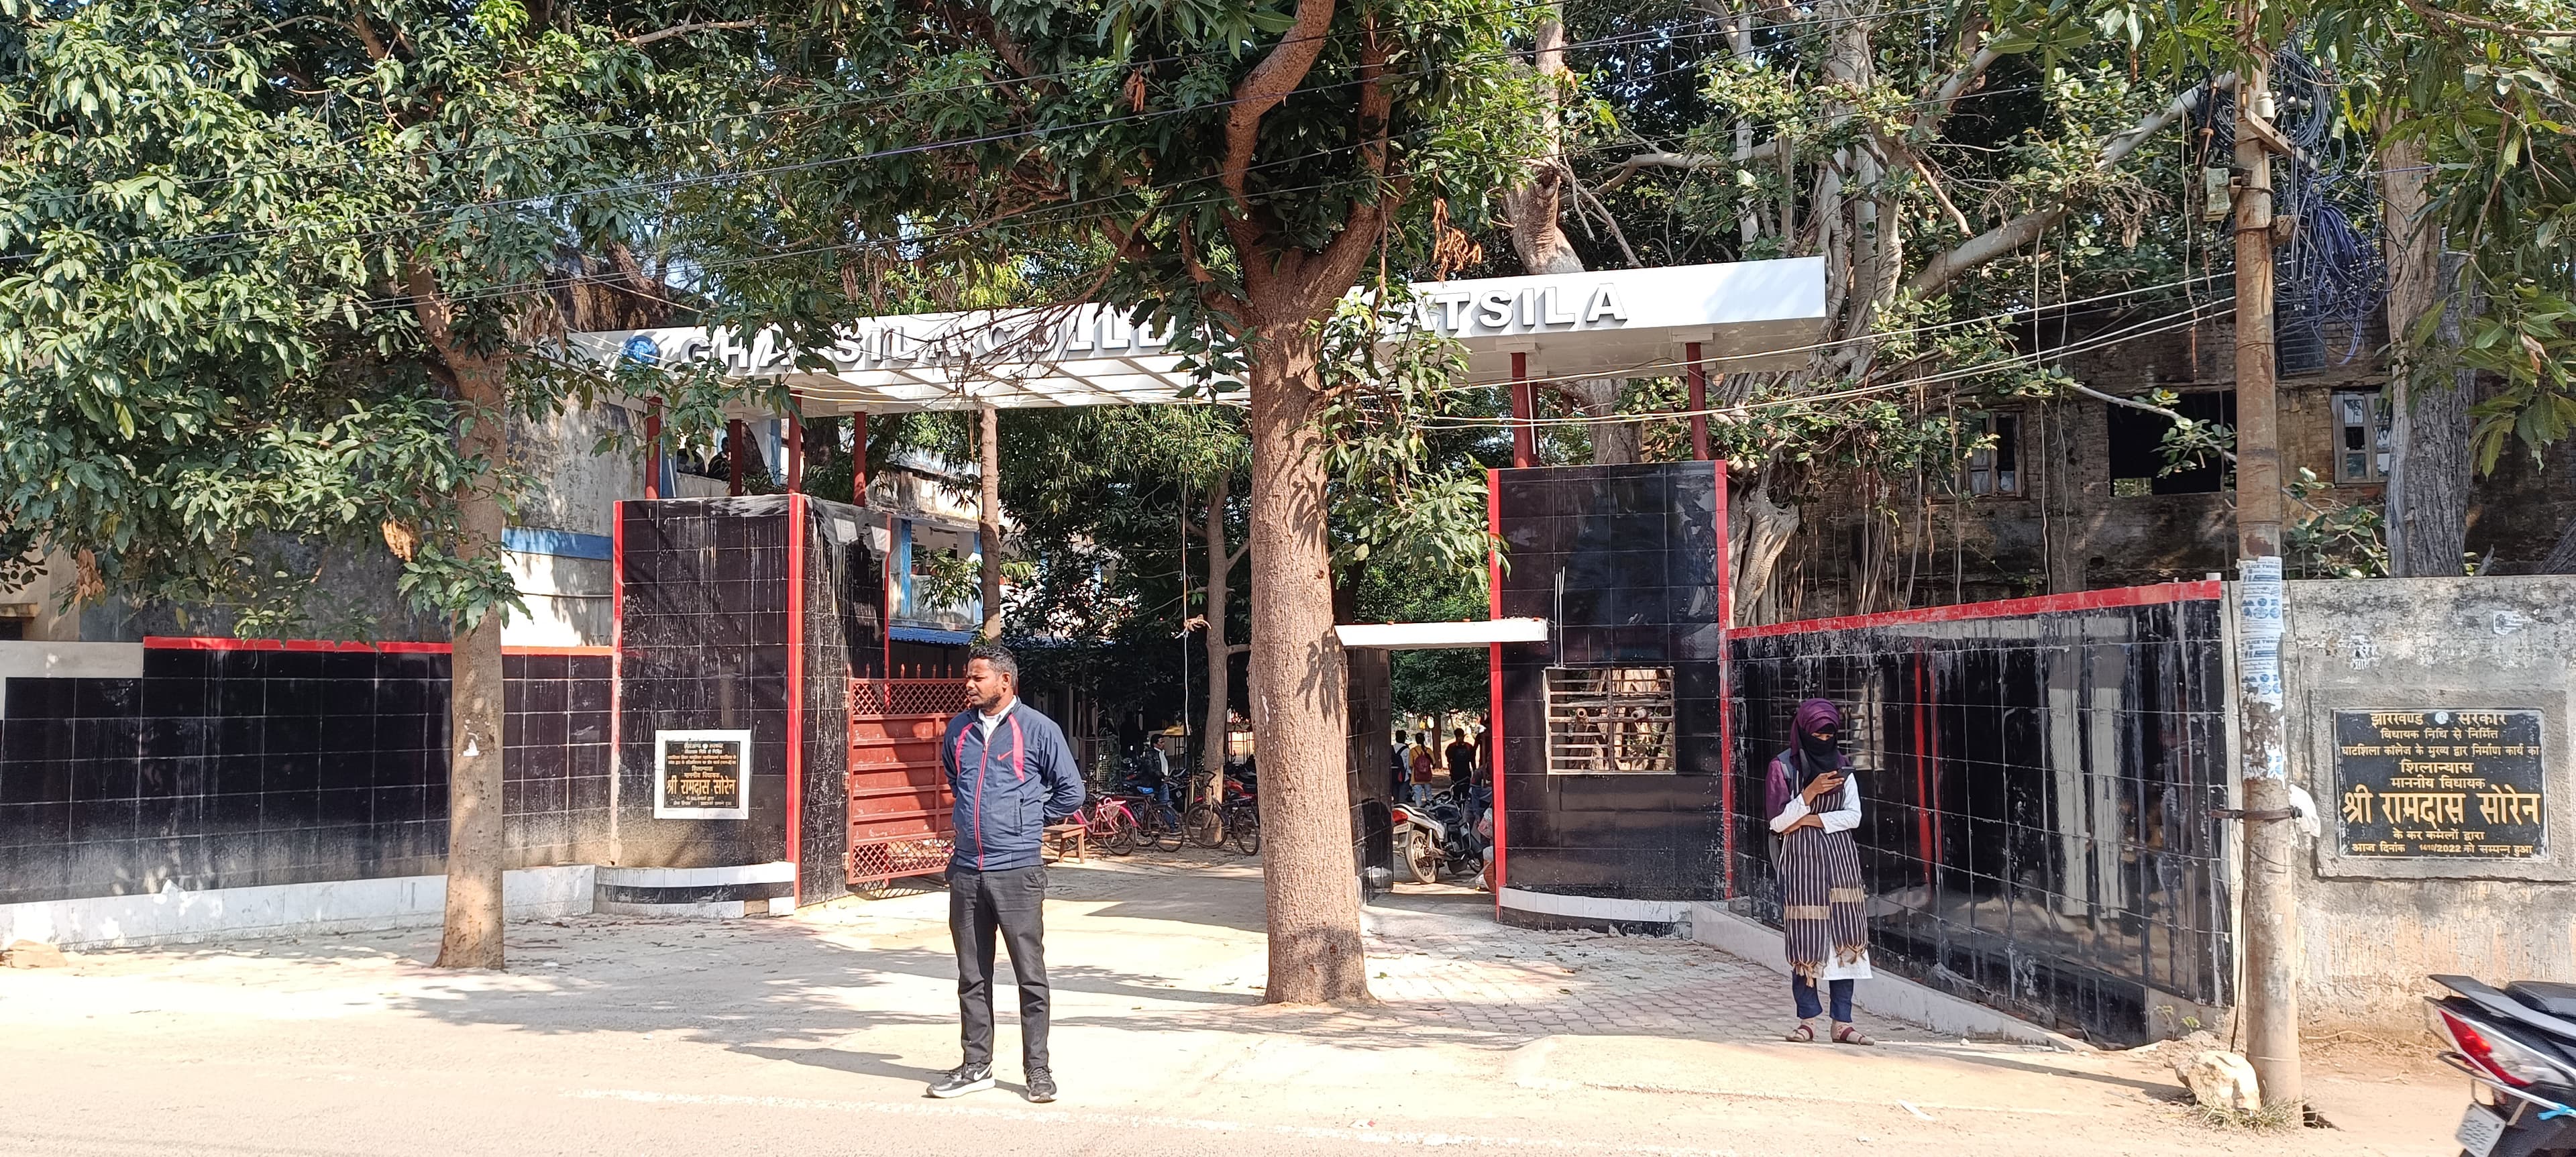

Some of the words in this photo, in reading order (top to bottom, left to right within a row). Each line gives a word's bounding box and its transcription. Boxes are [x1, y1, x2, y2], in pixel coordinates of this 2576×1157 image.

[680, 324, 963, 368] GHASILA
[981, 306, 1211, 357] COLLE
[2370, 713, 2424, 728] झारखण्ड
[2456, 713, 2508, 725] सरकार
[2380, 728, 2419, 739] विधायक
[2424, 728, 2449, 739] निधि
[2451, 728, 2462, 740] से
[2467, 727, 2498, 739] निर्मित
[2341, 743, 2381, 756] घाटशिला
[2383, 742, 2412, 755] कॉलेज
[2414, 743, 2424, 756] के
[2428, 746, 2449, 758] मुख्य
[2453, 746, 2468, 757] द्वार
[2471, 743, 2502, 756] निर्माण
[2504, 743, 2524, 756] कार्य
[2527, 746, 2540, 756] का
[2399, 759, 2474, 773] शिलान्यास
[667, 775, 678, 794] श्री
[680, 779, 710, 795] रामदास
[712, 775, 736, 794] सोरेन
[2390, 774, 2434, 788] माननीय
[2438, 775, 2485, 789] विधायक
[2343, 784, 2373, 824] श्री
[2379, 793, 2467, 830] रामदास
[2475, 784, 2540, 825] सोरेन
[2392, 828, 2404, 840] के
[2406, 830, 2423, 840] कर
[2462, 831, 2485, 841] द्वारा
[2352, 843, 2376, 852] आज
[2379, 840, 2406, 852] दिनांक
[2463, 842, 2475, 853] को
[2477, 844, 2511, 854] सम्पन्न
[2513, 845, 2533, 856] हुआ
